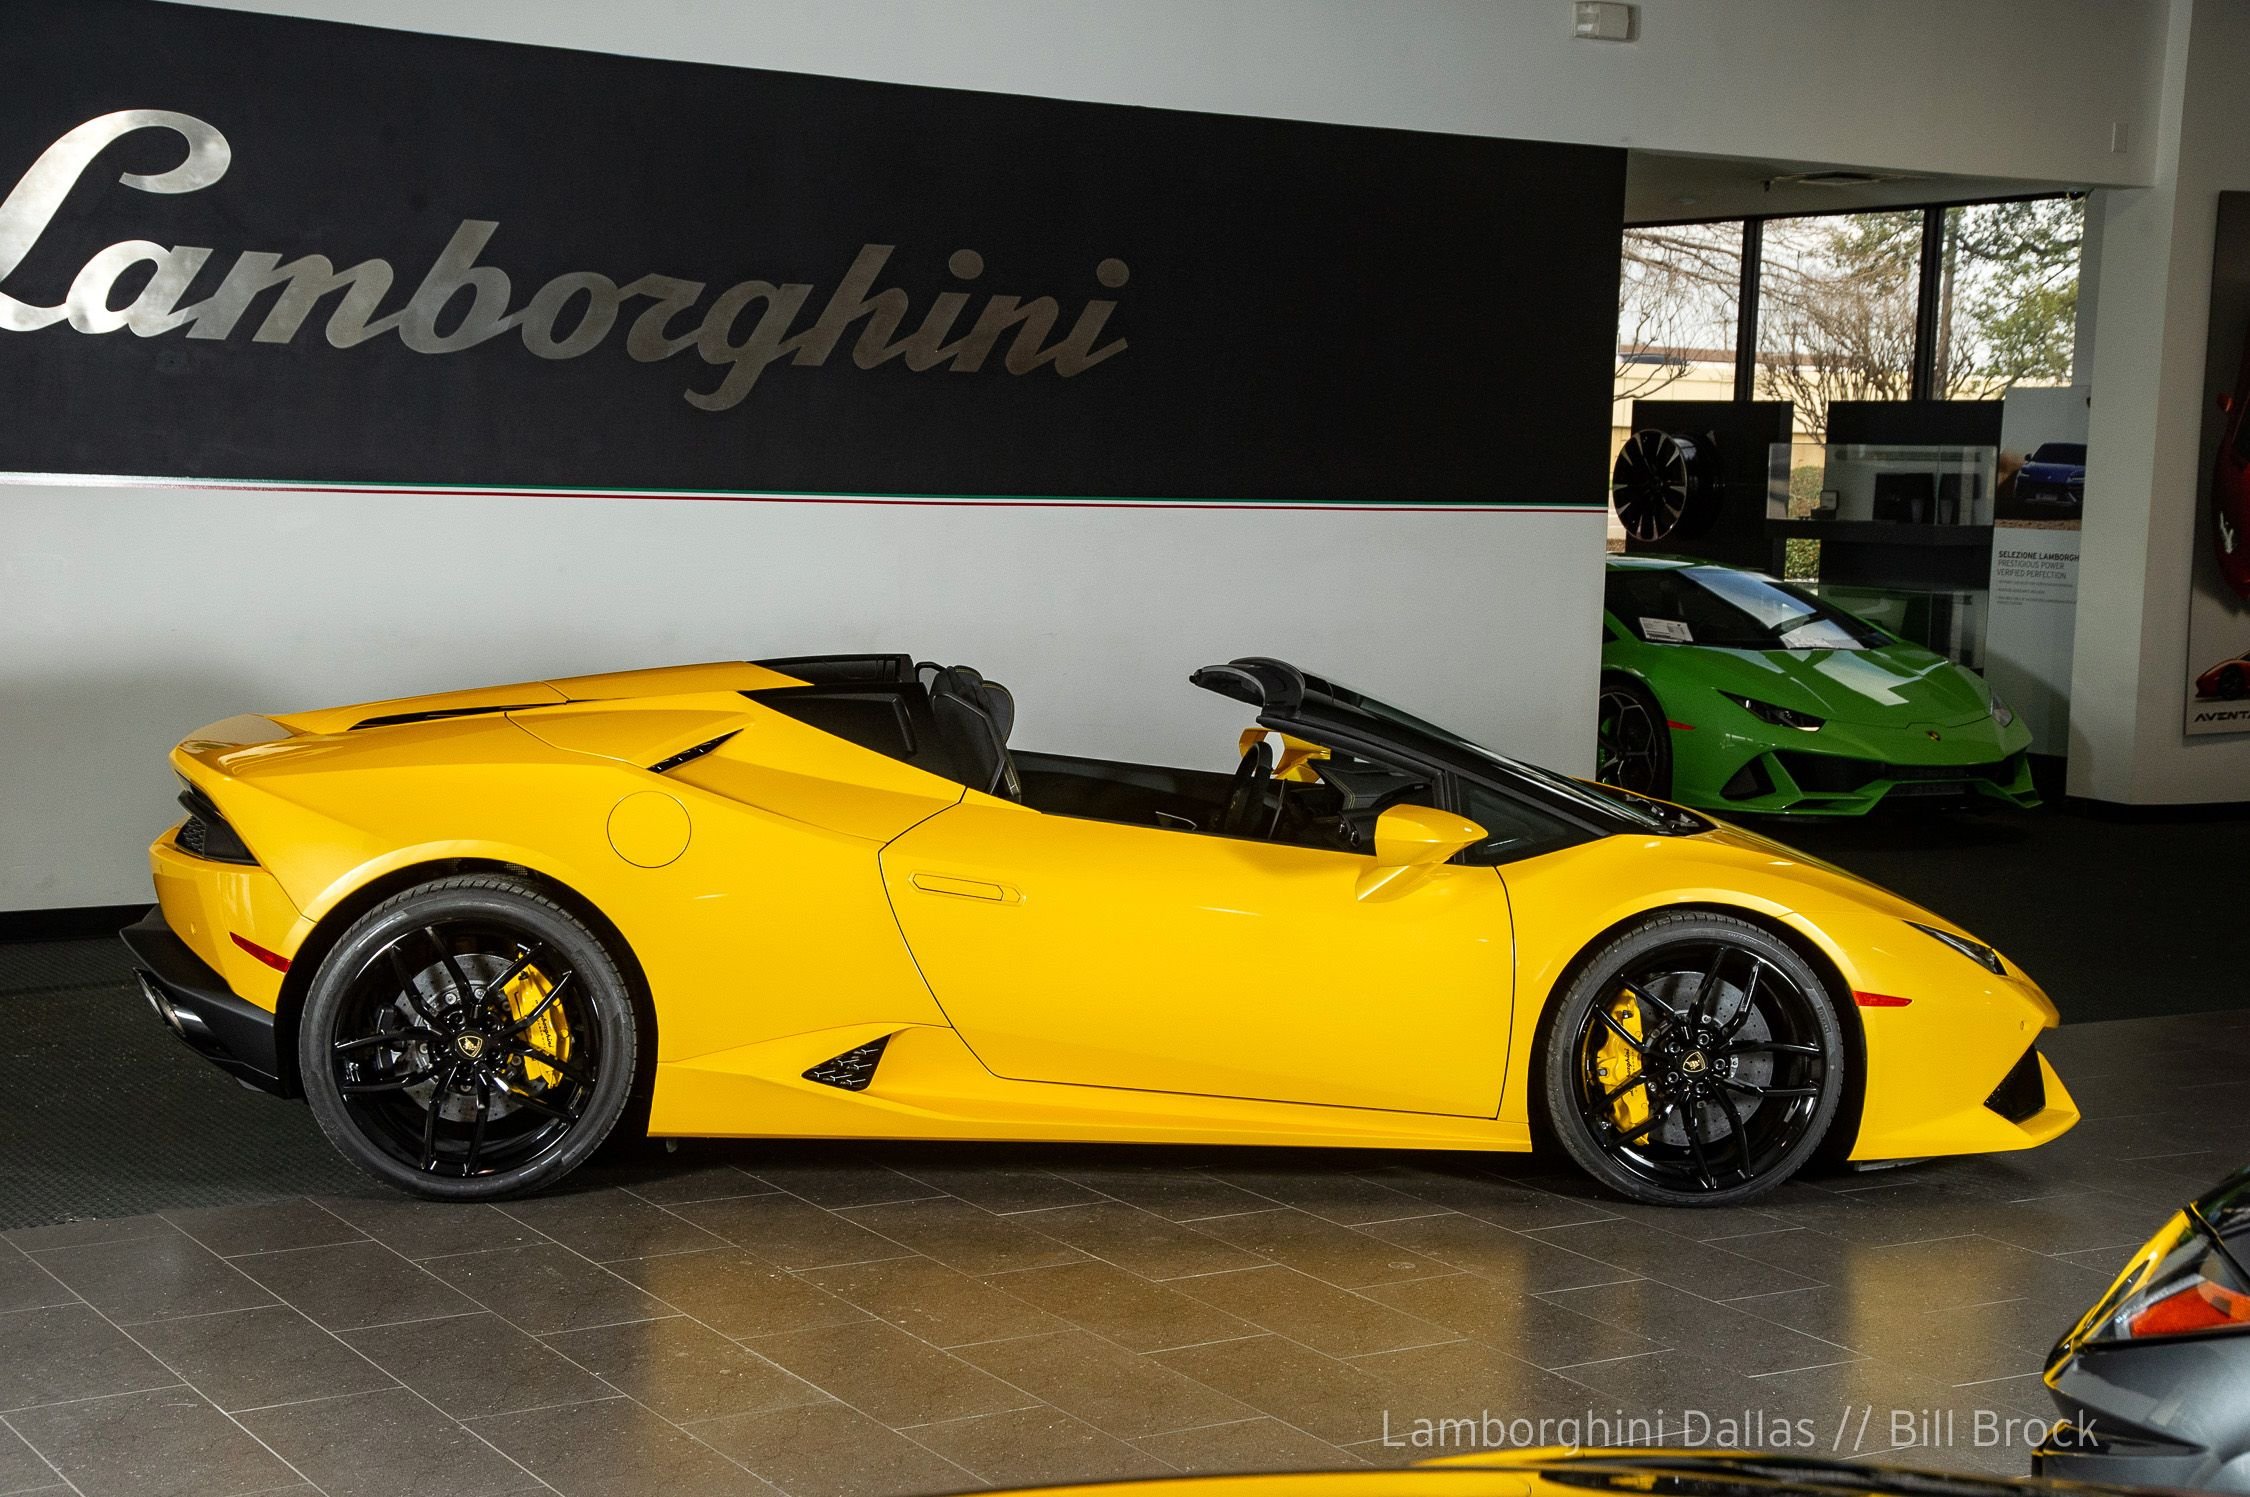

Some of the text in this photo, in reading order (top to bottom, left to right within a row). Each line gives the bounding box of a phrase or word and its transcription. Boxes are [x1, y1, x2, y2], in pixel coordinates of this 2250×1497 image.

[0, 109, 1131, 411] Lamborghini
[1998, 551, 2037, 560] SELEZIONE
[1998, 559, 2064, 569] PRESTIGIOUS POWER
[1998, 568, 2066, 579] VERIFIED PERFECTION
